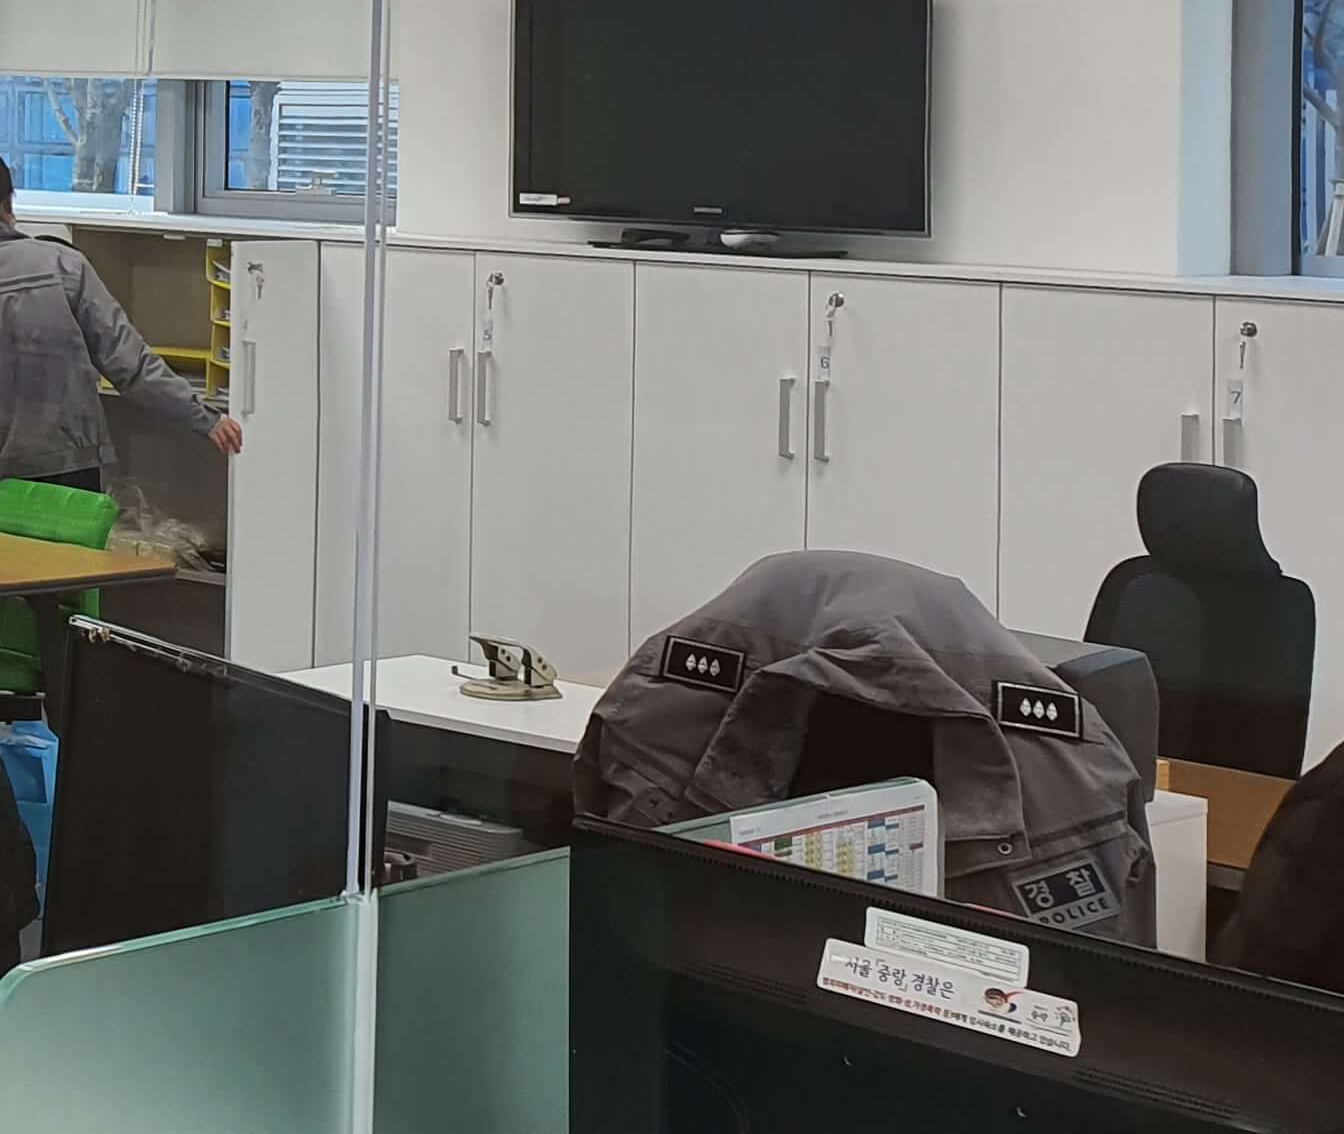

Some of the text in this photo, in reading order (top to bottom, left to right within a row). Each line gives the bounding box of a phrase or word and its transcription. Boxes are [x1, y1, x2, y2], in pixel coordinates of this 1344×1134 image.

[1024, 868, 1097, 909] 경찰
[1040, 897, 1110, 925] POLICE
[912, 973, 955, 999] 경찰은
